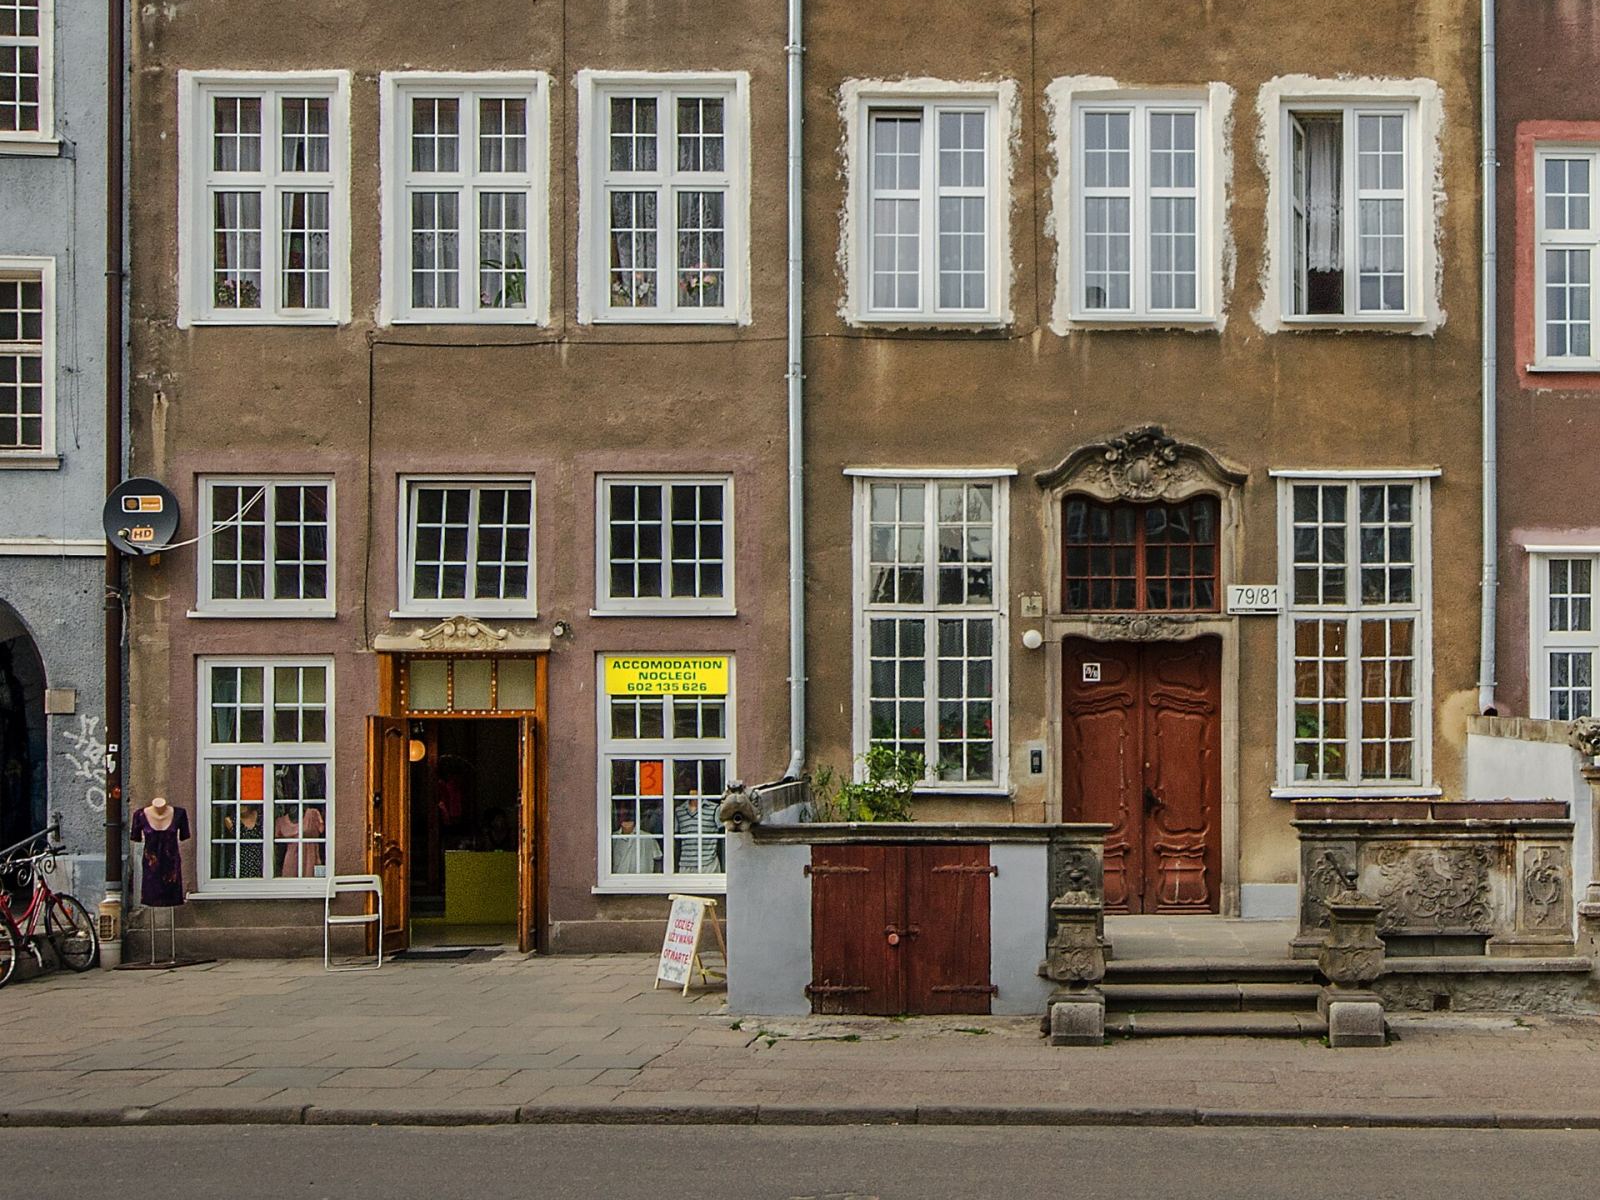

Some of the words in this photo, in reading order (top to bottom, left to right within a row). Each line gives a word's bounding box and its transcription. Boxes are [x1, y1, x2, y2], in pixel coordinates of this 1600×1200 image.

[133, 530, 152, 539] HD
[1235, 587, 1278, 605] 79/81
[613, 661, 722, 669] ACCOMODATION
[639, 672, 696, 680] NOCLEGI
[627, 682, 653, 692] 602
[656, 682, 680, 692] 135
[682, 682, 708, 692] 626
